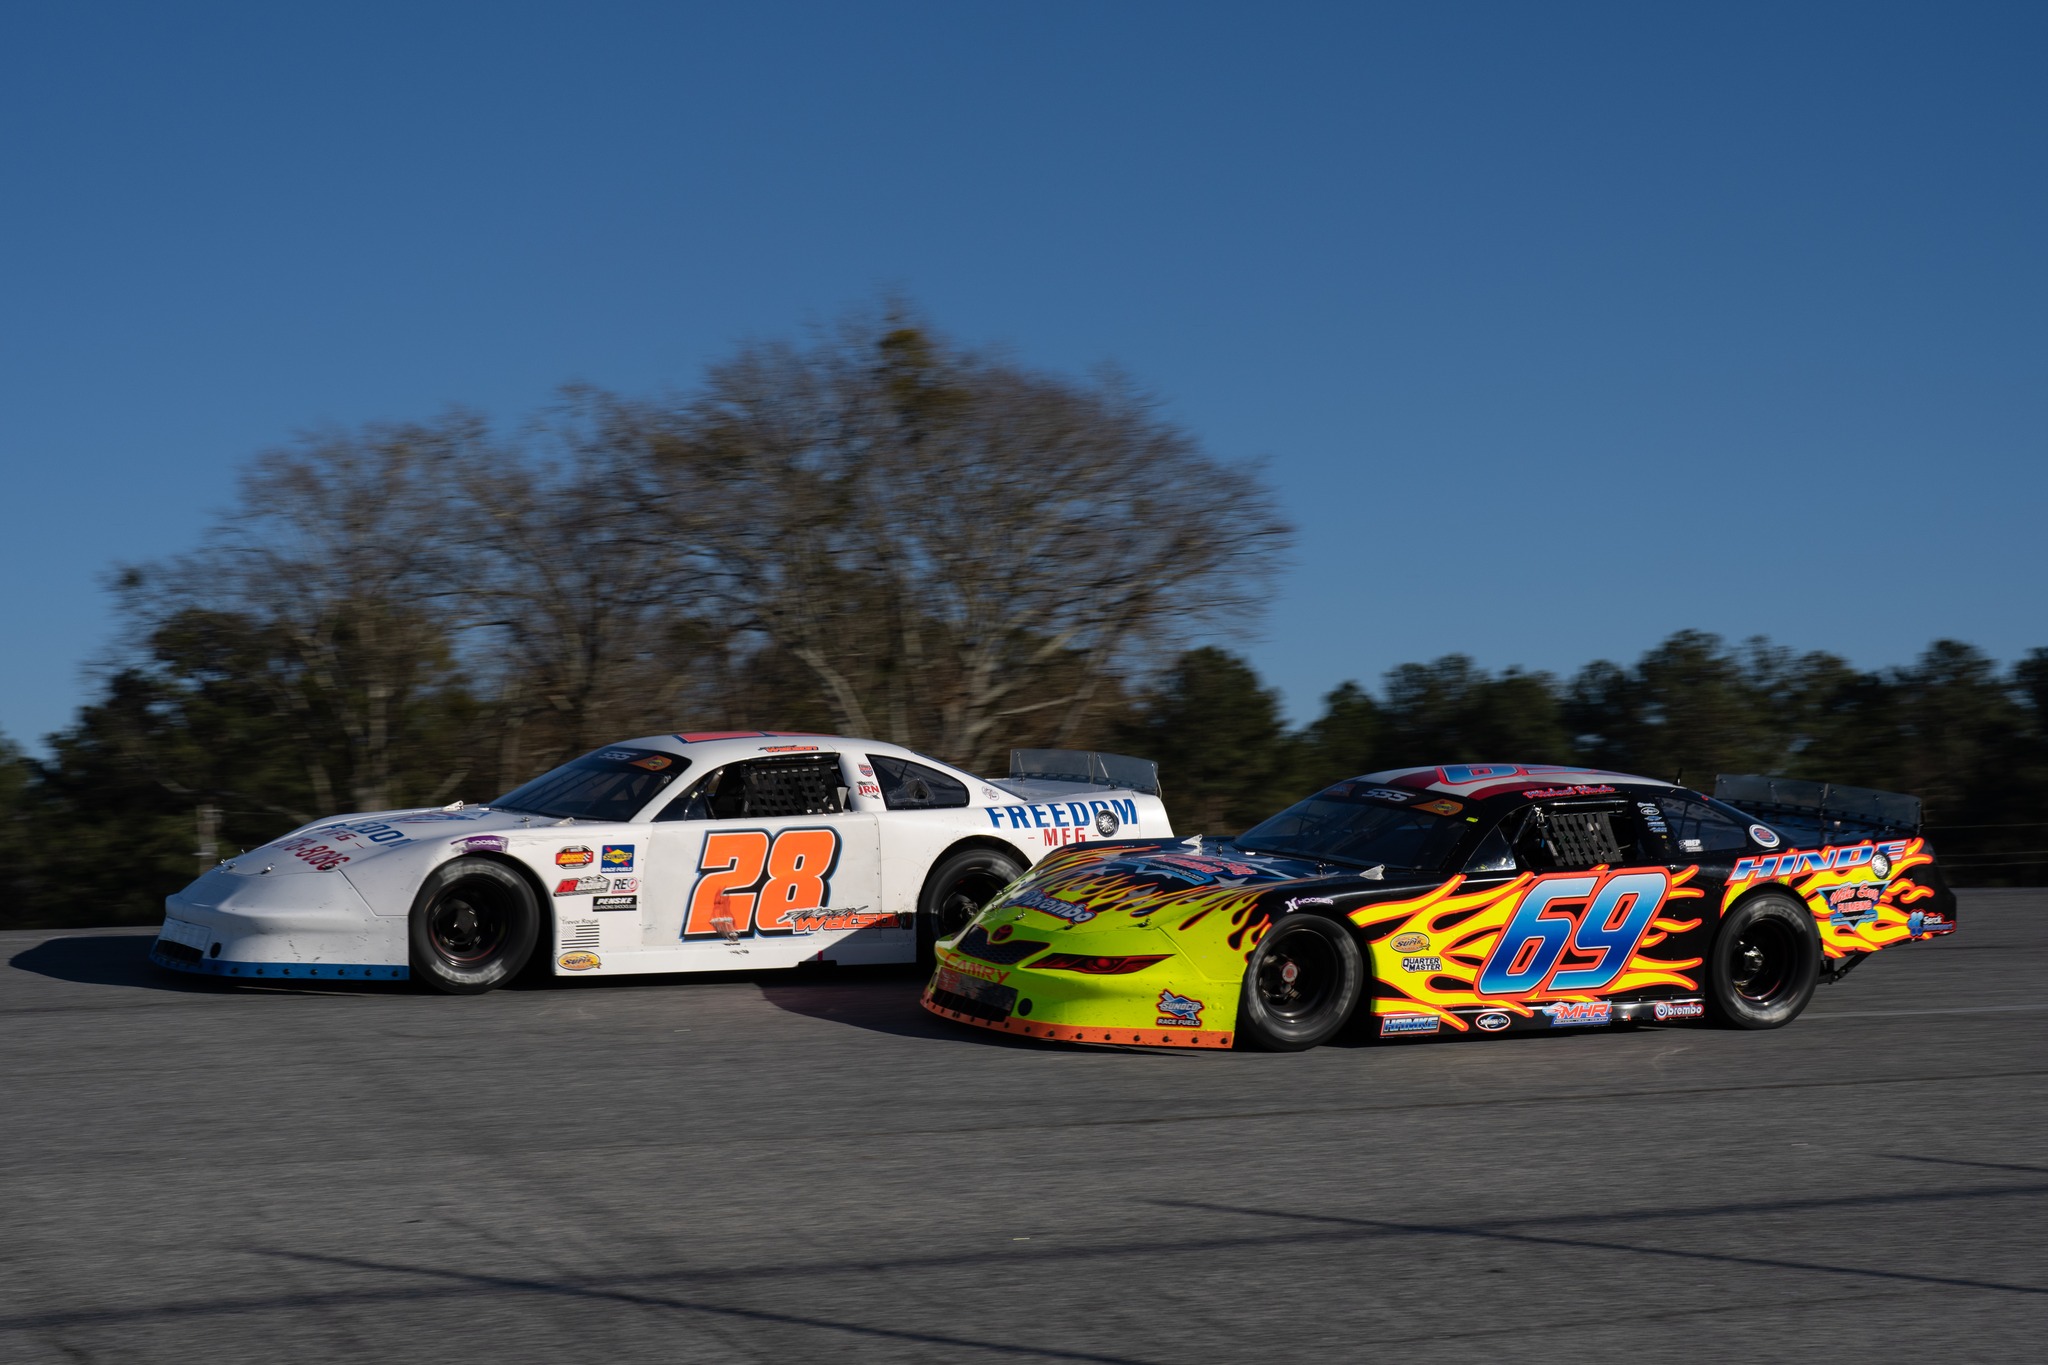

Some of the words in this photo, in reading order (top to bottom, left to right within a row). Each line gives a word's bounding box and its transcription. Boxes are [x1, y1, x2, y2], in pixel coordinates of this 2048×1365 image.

[681, 826, 842, 941] 28
[596, 897, 634, 905] PENSKE
[1476, 869, 1669, 997] 69
[1402, 957, 1440, 967] QUARTER
[1409, 963, 1441, 971] MASTER
[944, 953, 1011, 984] CAMRY
[1161, 1001, 1200, 1012] SUNOCO
[1560, 1004, 1609, 1019] MHR
[1667, 1003, 1702, 1015] brembo
[1178, 1018, 1201, 1026] FUELS
[1384, 1016, 1438, 1032] HAMKE
